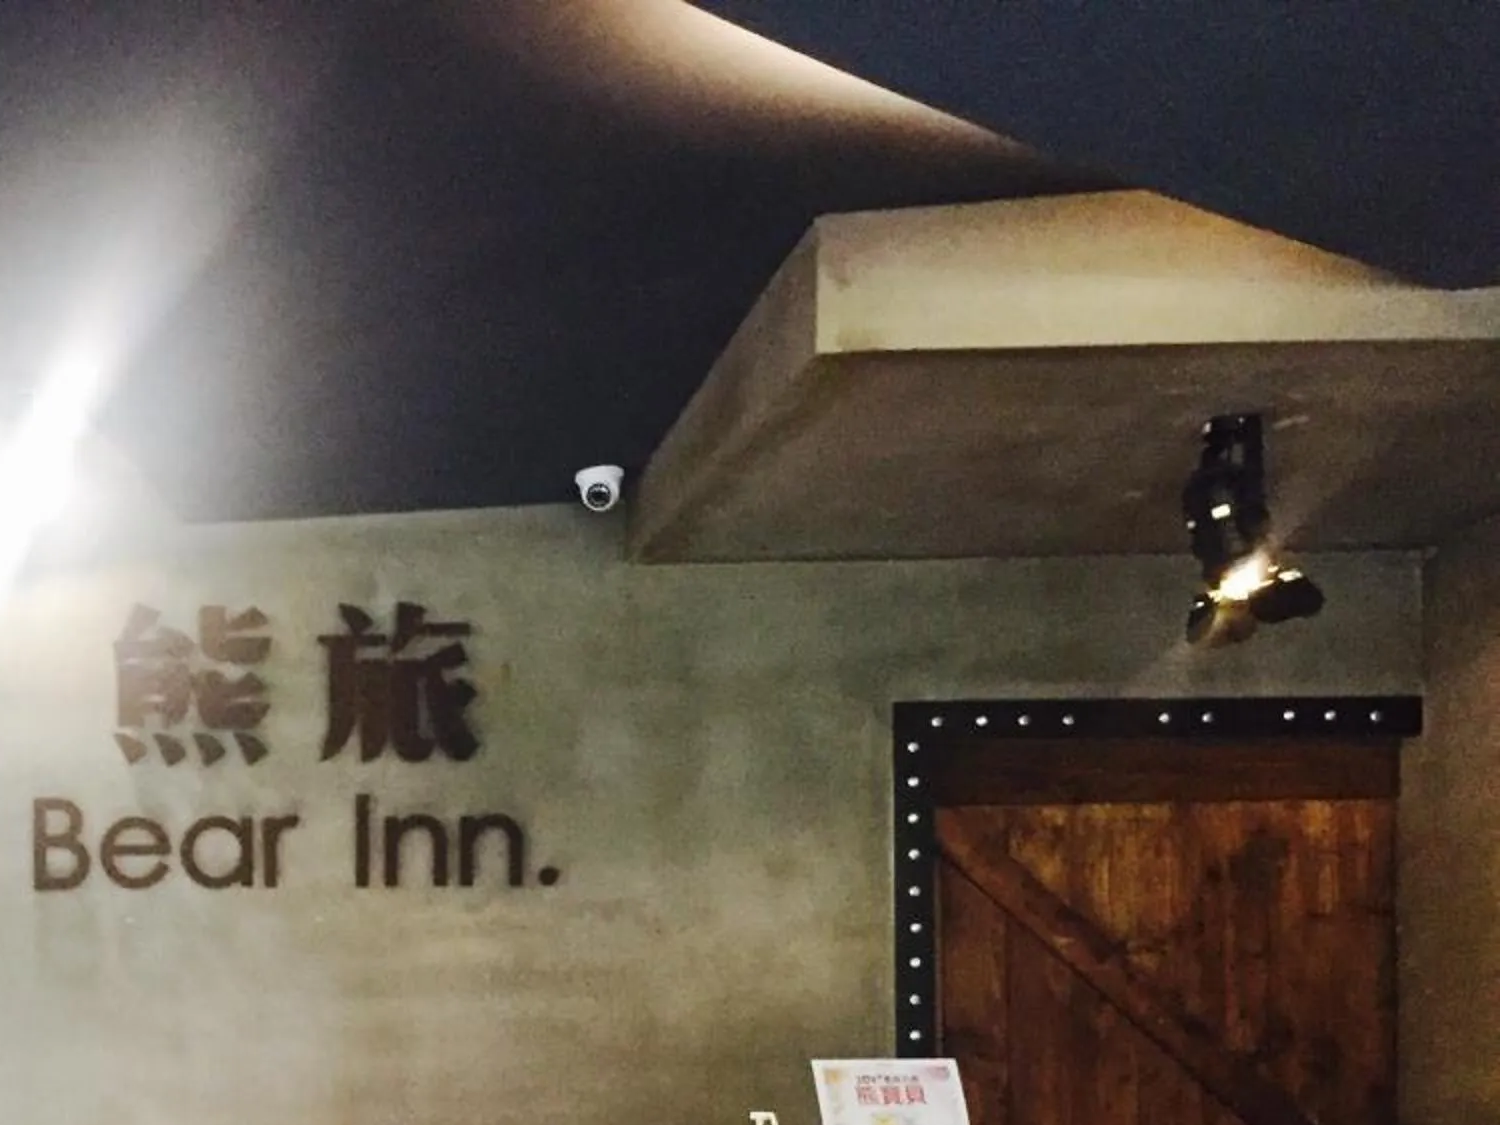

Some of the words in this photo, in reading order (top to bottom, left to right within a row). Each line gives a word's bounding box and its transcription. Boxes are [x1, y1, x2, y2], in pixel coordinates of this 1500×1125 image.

[113, 600, 481, 767] 熊旅
[32, 797, 300, 892] Bear
[354, 793, 561, 889] Inn.
